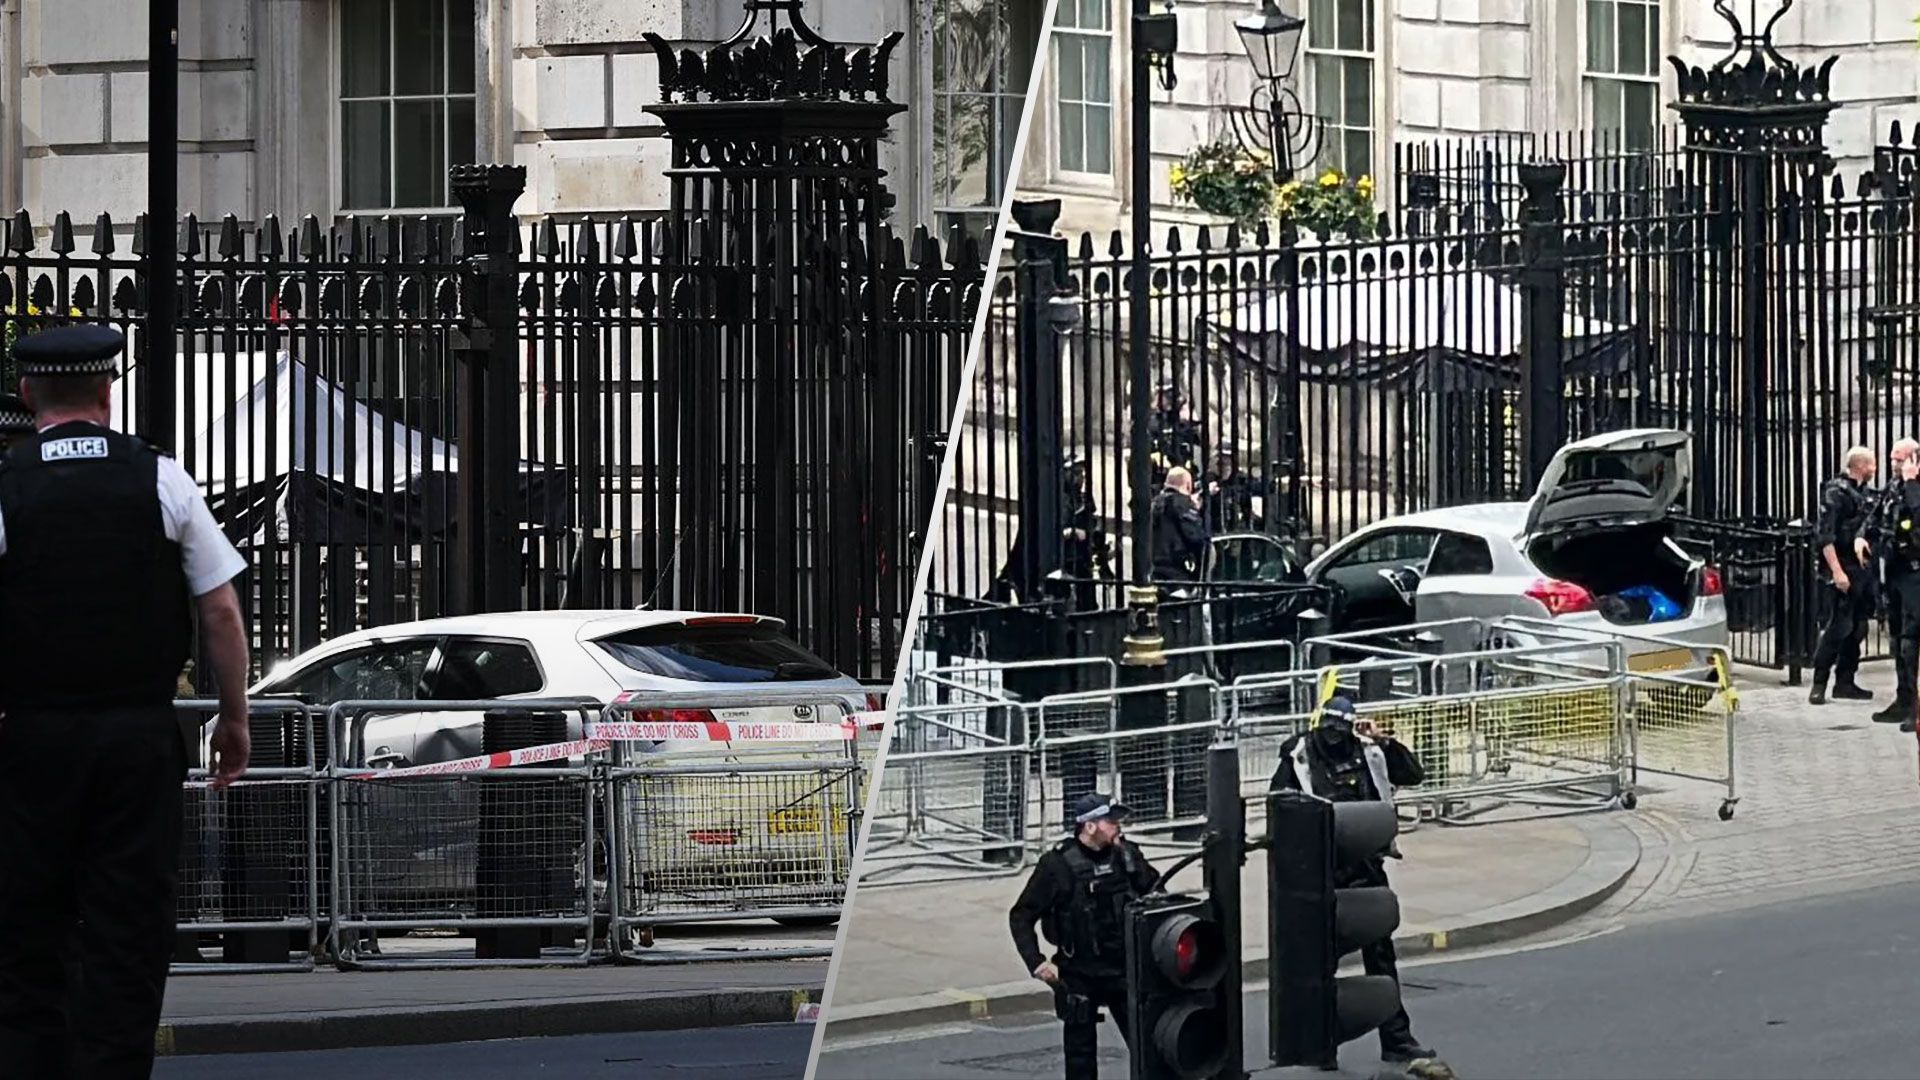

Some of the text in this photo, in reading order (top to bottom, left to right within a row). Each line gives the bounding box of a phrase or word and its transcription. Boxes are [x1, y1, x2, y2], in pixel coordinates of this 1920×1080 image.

[45, 440, 103, 457] POLICE
[595, 724, 699, 739] POLICE LINE DO NOT CROSS
[738, 724, 763, 739] POLICE
[764, 724, 780, 739] LINE
